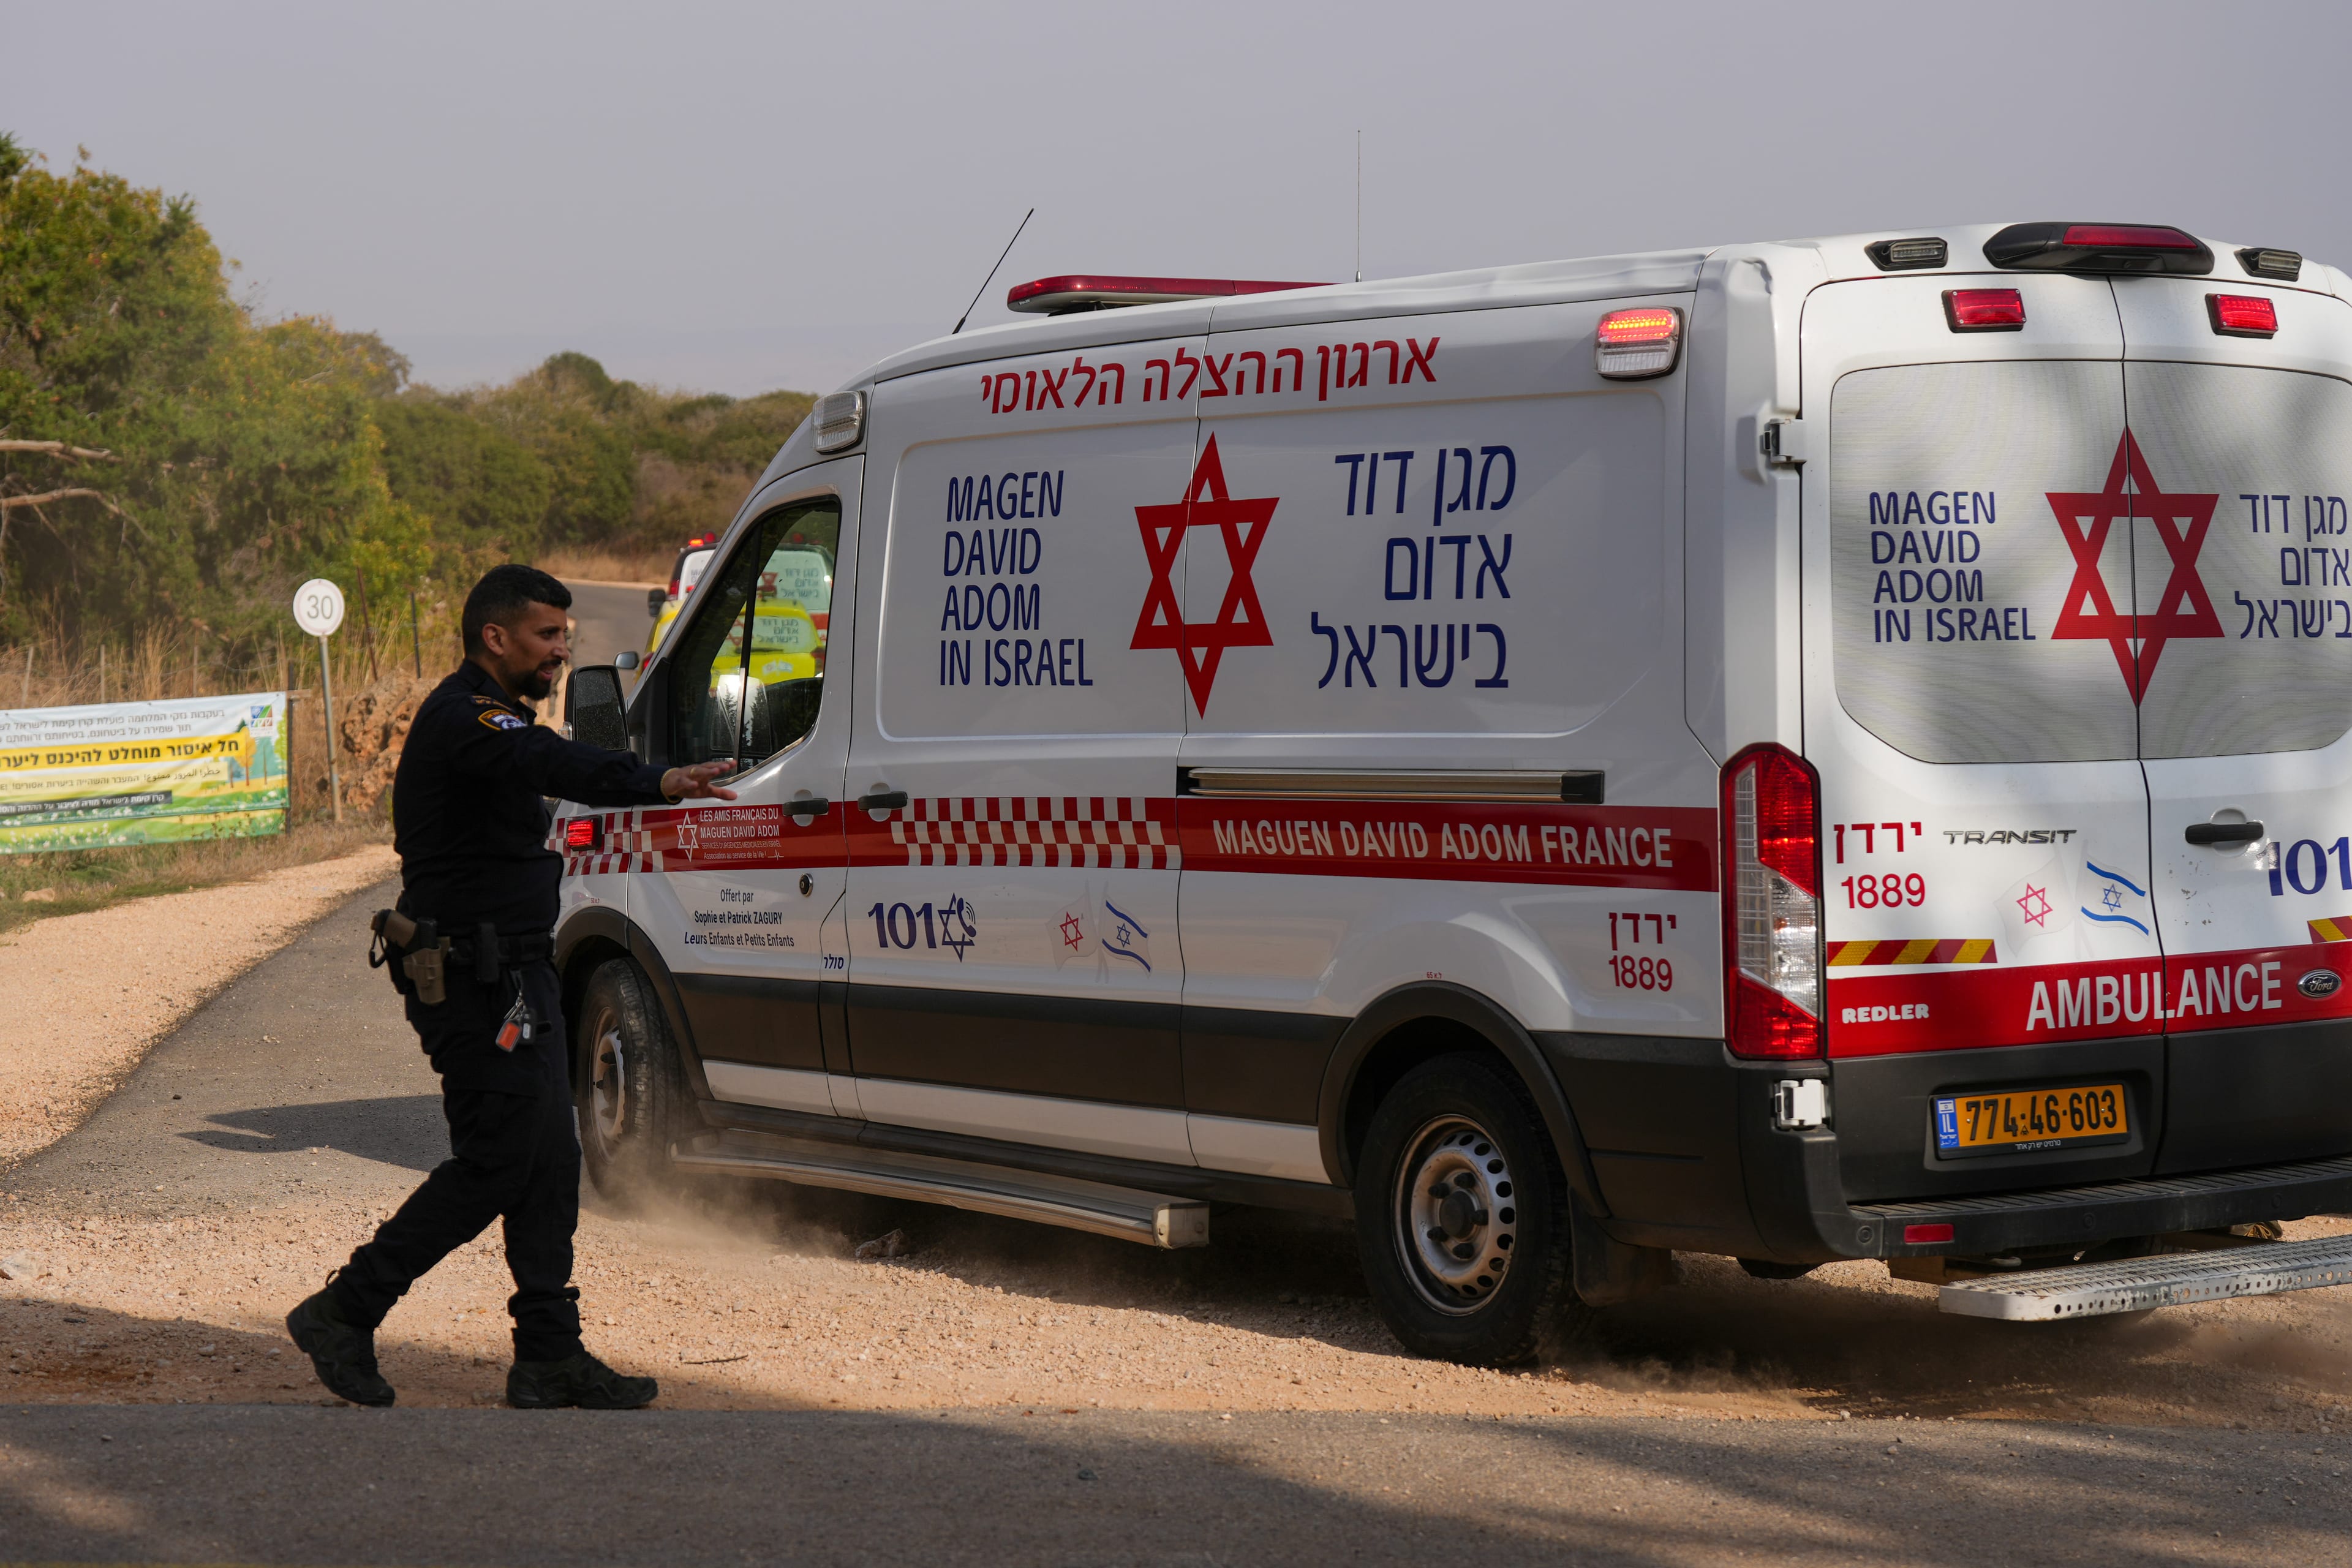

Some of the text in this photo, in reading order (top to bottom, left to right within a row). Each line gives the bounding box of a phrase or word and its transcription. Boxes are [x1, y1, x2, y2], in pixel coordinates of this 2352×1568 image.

[981, 337, 1441, 414] ארגון ההצלה הלאומי
[946, 470, 1065, 522] MAGEN
[1335, 445, 1517, 527] מגן דוד
[1869, 491, 1996, 525] MAGEN
[2240, 494, 2347, 542] מגן דוד
[944, 529, 1042, 577] DAVID
[1871, 530, 1980, 565] DAVID
[1384, 533, 1513, 601] אדום
[2280, 548, 2351, 586] אדום
[1874, 568, 1983, 604] ADOM
[307, 594, 333, 620] 30
[941, 582, 1040, 631] ADOM
[2234, 590, 2352, 639] בישראל
[1874, 607, 2036, 643] IN ISRAEL
[940, 639, 1093, 687] IN ISRAEL
[1311, 611, 1510, 689] בישראל
[14, 721, 48, 730] לישראל
[52, 720, 75, 729] קימת
[78, 719, 93, 728] קרן
[128, 713, 166, 723] המלחמה
[129, 727, 140, 736] על
[144, 725, 173, 734] שמירה
[0, 739, 239, 767] חל איסור מוחלט להיכנס ליער
[700, 808, 778, 823] LES AMIS FRANÇAIS DU
[700, 824, 780, 839] MAGUEN DAVID ADOM
[1213, 820, 1673, 867] MAGUEN DAVID ADOM FRANCE
[1834, 821, 1922, 864] ירדן
[1943, 829, 2077, 845] TRANSIT
[704, 851, 725, 860] Association
[2256, 837, 2352, 897] 101
[720, 889, 753, 905] Offert par
[1841, 872, 1926, 910] 1889
[695, 910, 782, 926] Sophie et Patrick ZAGURY
[868, 902, 937, 949] 101
[1609, 913, 1676, 951] ירדן
[685, 932, 794, 947] Leurs Enfants et Petits Enfants
[824, 953, 844, 970] סולר
[1609, 955, 1673, 992] 1889
[2026, 962, 2282, 1031] AMBULANCE
[2309, 976, 2334, 992] Ford
[1842, 1003, 1929, 1023] REDLER
[1942, 1114, 1954, 1133] IL
